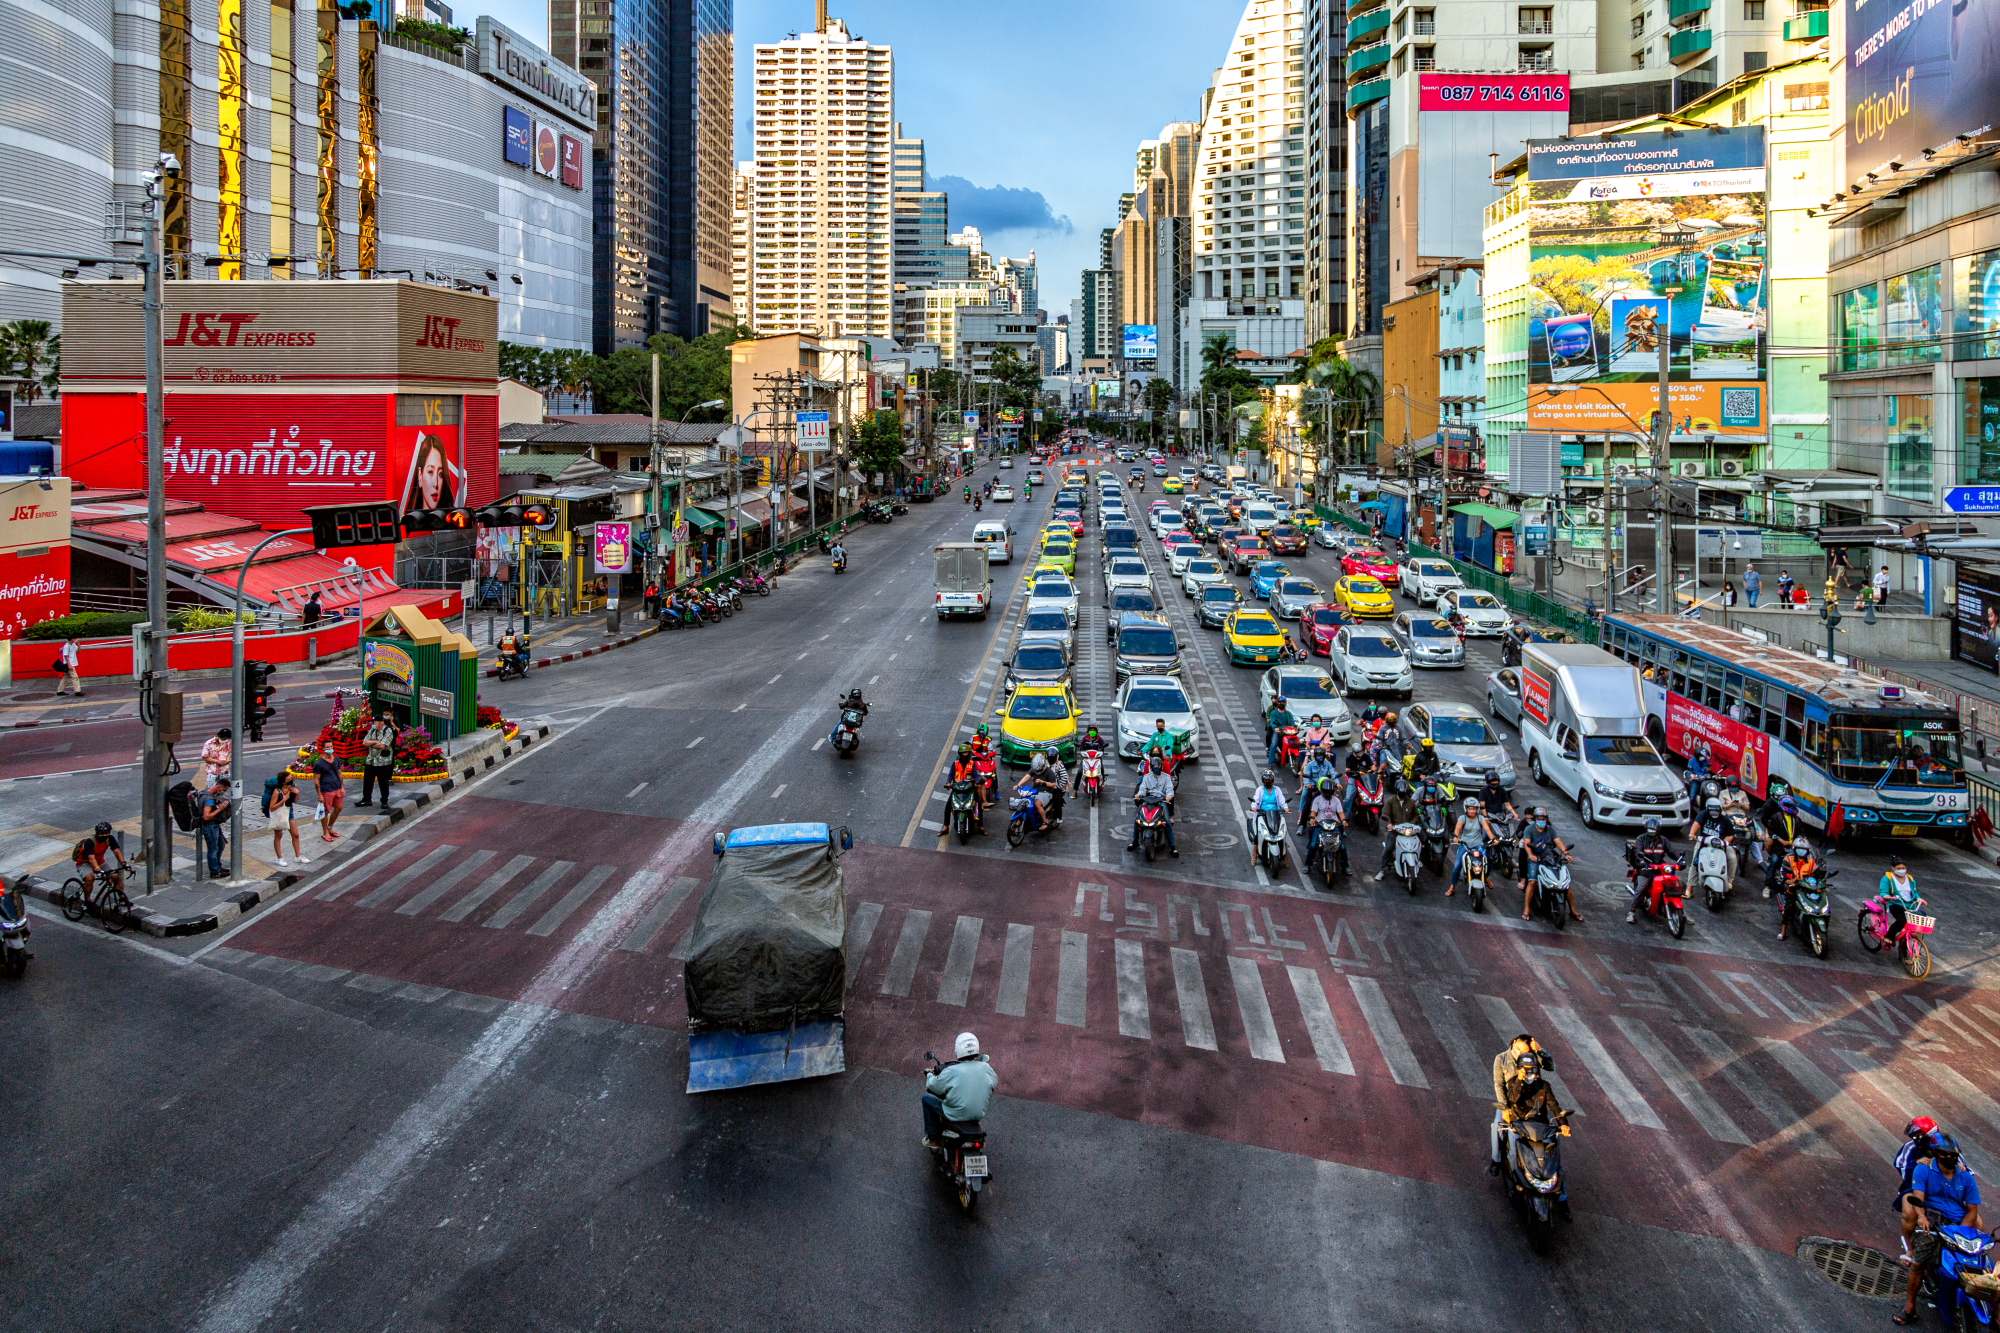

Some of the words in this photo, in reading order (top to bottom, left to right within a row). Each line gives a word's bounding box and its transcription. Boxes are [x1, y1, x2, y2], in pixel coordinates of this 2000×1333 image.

[1854, 27, 1885, 67] THERE'S
[1886, 5, 1911, 43] MORE
[1912, 0, 1925, 21] TO
[1440, 86, 1475, 101] 087
[1480, 86, 1515, 101] 714
[1519, 86, 1565, 101] 6116
[1707, 178, 1752, 187] KTOThailand
[1589, 186, 1618, 198] Korea
[163, 312, 260, 347] J&T
[243, 332, 316, 347] EXPRESS
[415, 315, 462, 350] J&T
[454, 338, 485, 353] EXPRESS
[1689, 384, 1706, 394] off,
[1678, 394, 1702, 402] 350.-
[424, 399, 442, 426] VS
[1574, 402, 1594, 410] visit
[1595, 402, 1626, 410] Korea?
[1983, 404, 1999, 414] Drive
[1583, 410, 1609, 418] virtual
[1963, 492, 1974, 501] ถ.
[9, 504, 41, 521] J&T
[35, 510, 58, 519] EXPRESS
[182, 540, 248, 562] J&T
[0, 573, 66, 602] ส่งทุกที่ทั่วไทย
[235, 781, 241, 789] 4
[1936, 794, 1957, 808] 98
